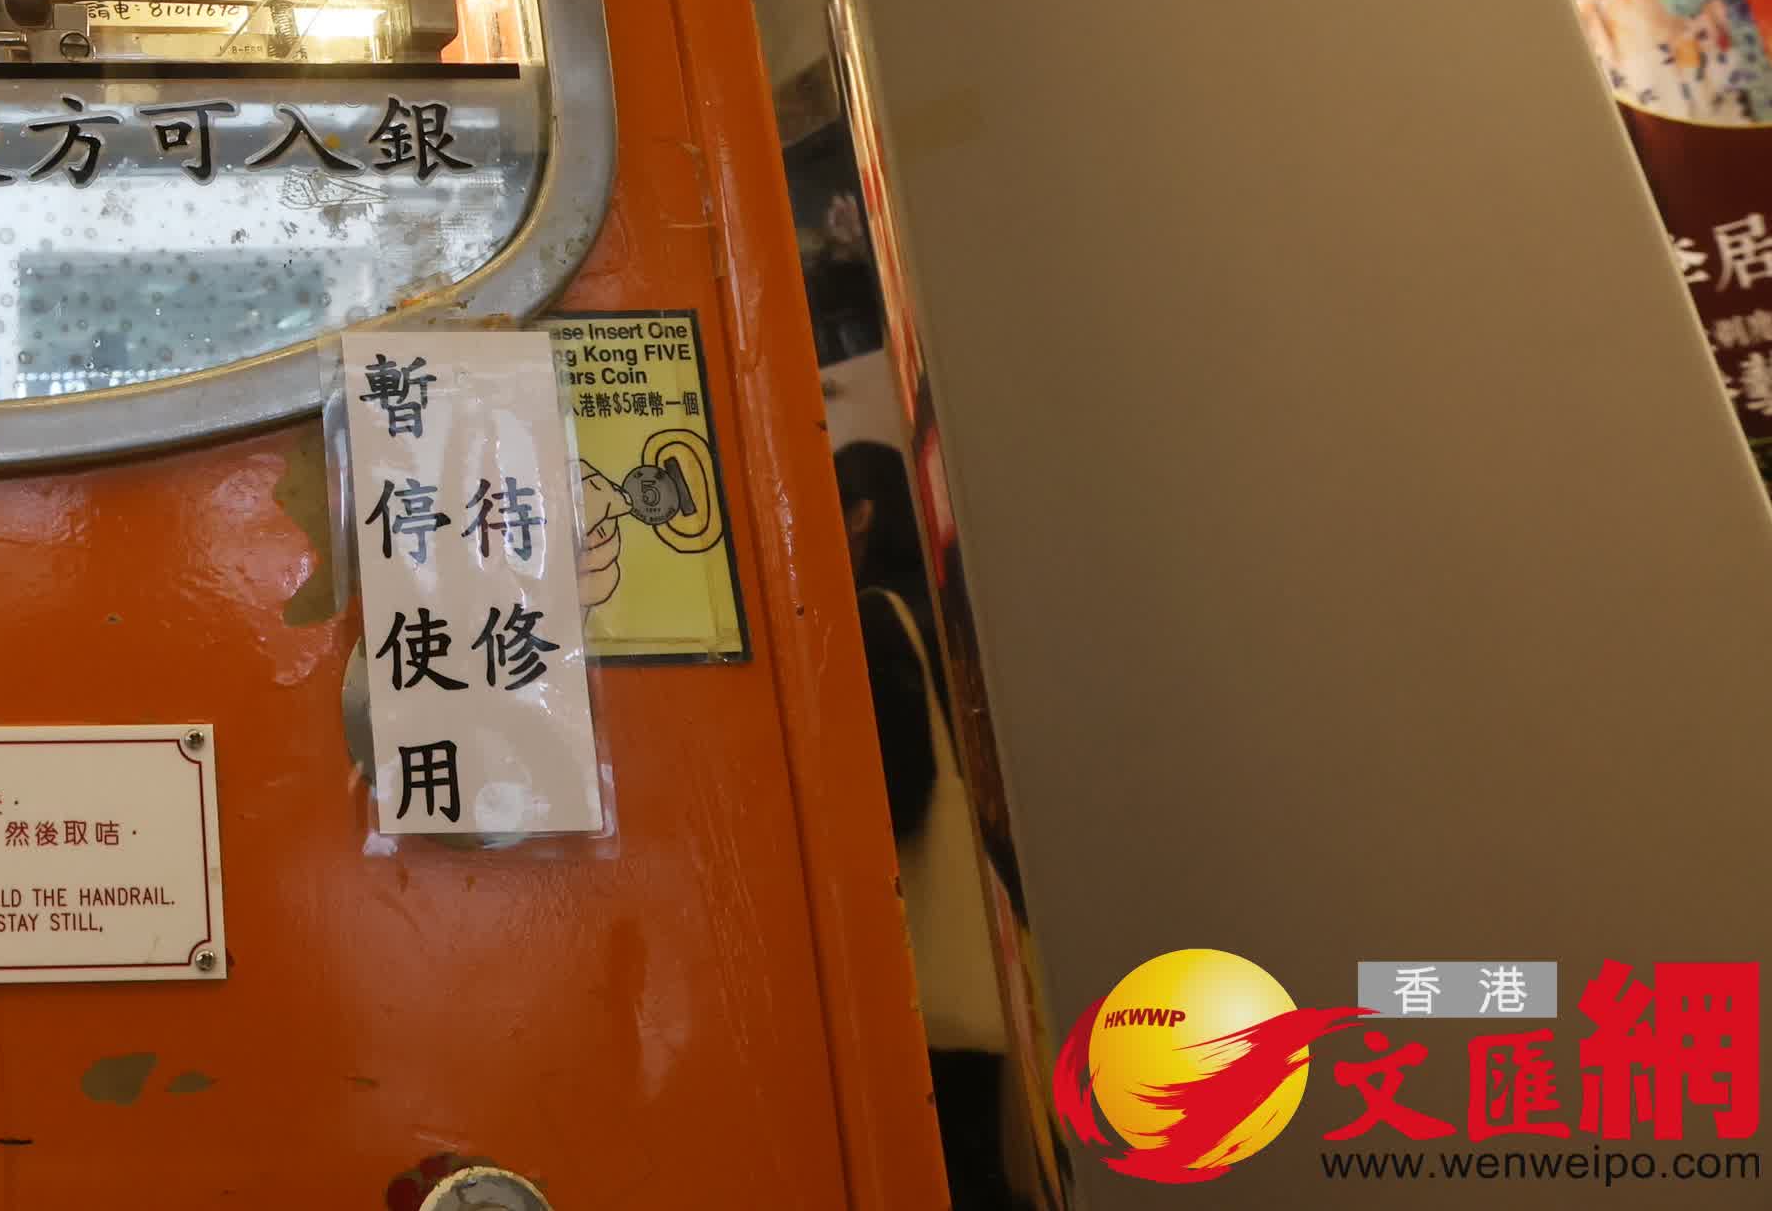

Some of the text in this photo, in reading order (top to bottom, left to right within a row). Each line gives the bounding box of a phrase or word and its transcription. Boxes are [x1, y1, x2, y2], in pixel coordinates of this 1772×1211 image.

[588, 323, 643, 340] Insert
[648, 322, 687, 338] One
[583, 345, 637, 366] Kong
[644, 344, 691, 361] FIVE
[601, 367, 647, 384] Coin
[359, 354, 469, 823] 暫停使用
[460, 477, 560, 690] 待修
[31, 888, 67, 907] THE
[79, 887, 176, 906] HANDRAIL.
[50, 913, 103, 932] STILL,
